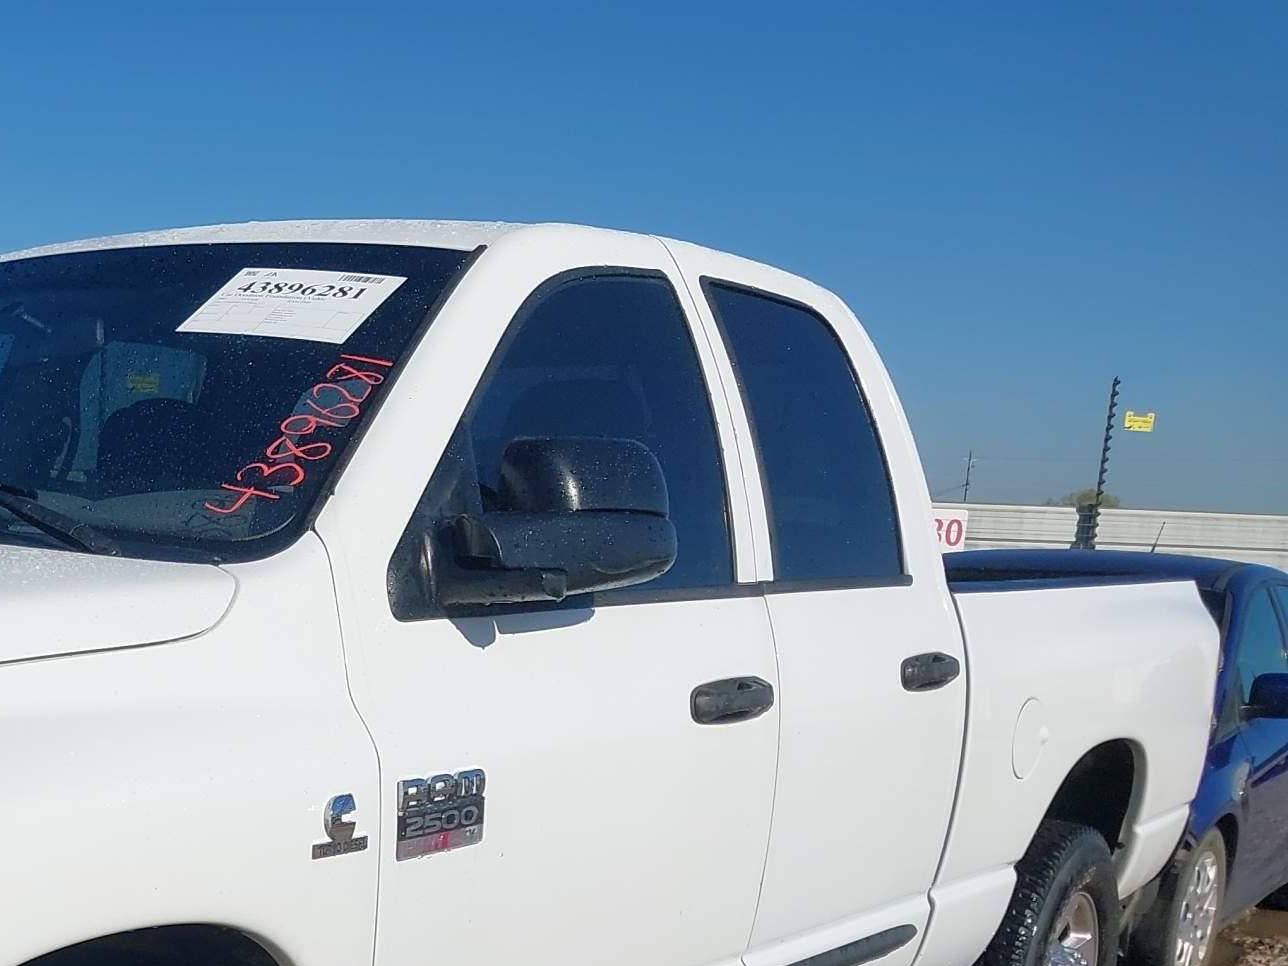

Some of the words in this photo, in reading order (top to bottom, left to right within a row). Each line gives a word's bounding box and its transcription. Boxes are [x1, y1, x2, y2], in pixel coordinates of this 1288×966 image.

[238, 280, 368, 300] 43896281
[204, 354, 394, 514] 43896281
[405, 805, 480, 838] 2500
